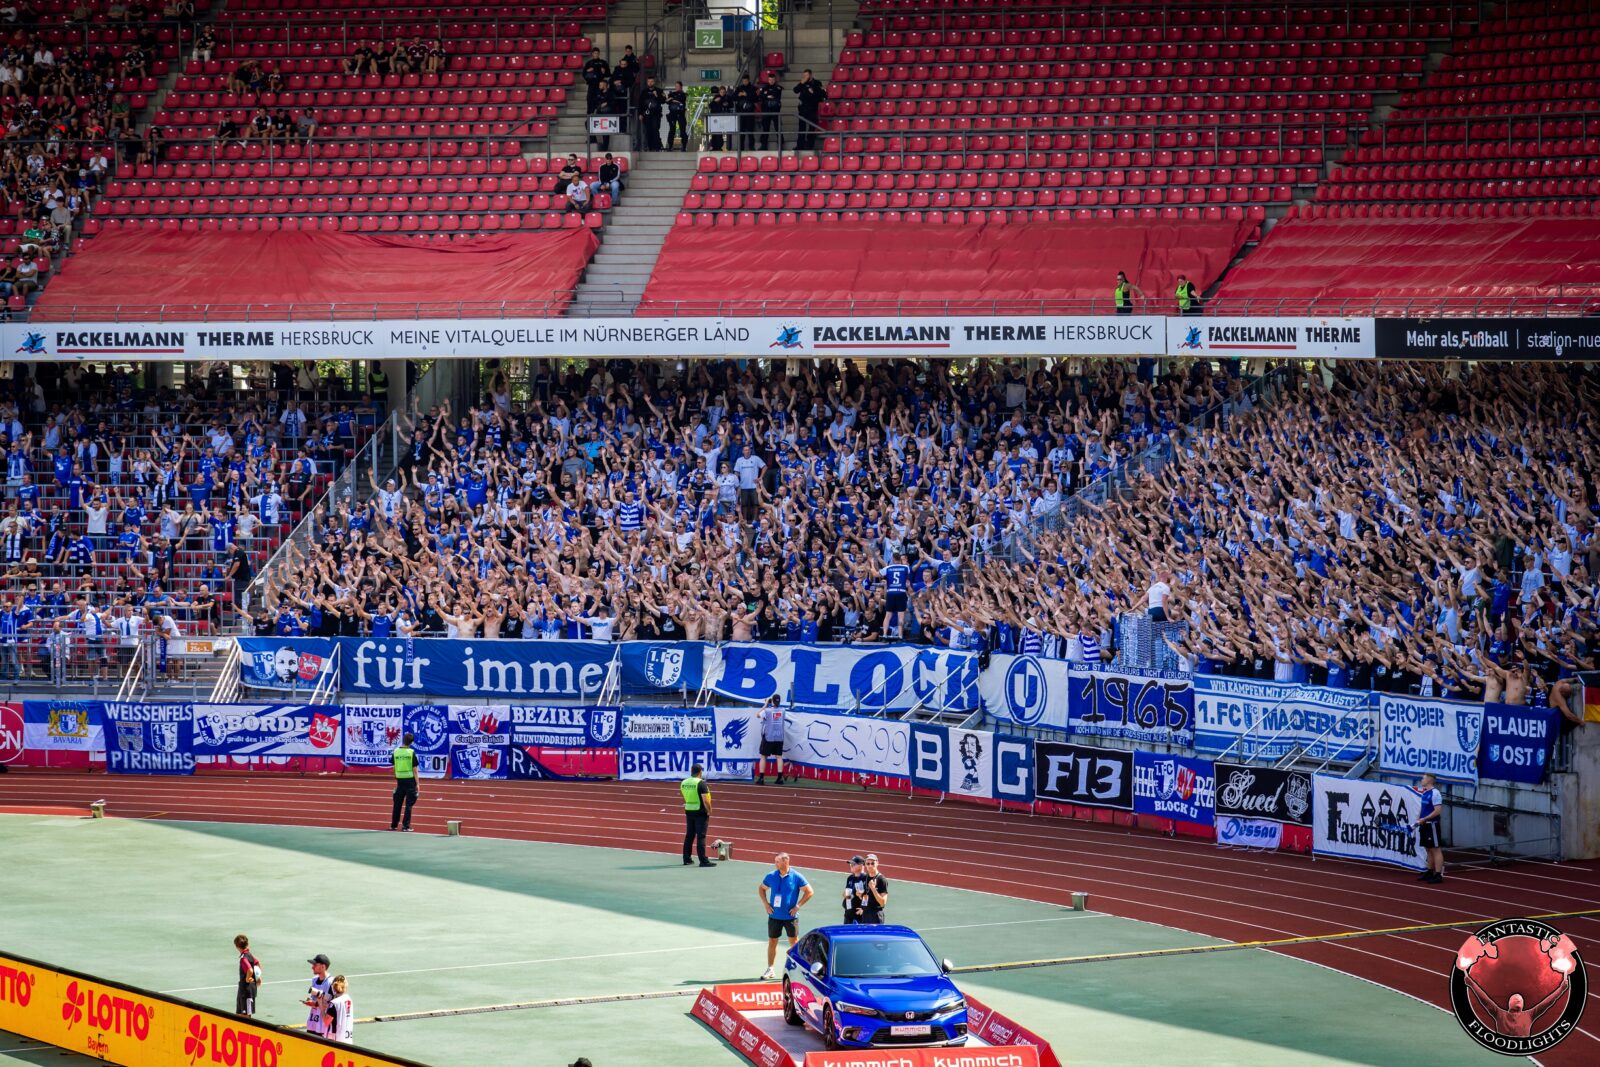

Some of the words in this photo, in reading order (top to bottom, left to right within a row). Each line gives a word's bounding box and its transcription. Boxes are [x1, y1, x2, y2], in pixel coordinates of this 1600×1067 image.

[703, 35, 715, 45] 24
[593, 118, 617, 130] FCN
[57, 331, 184, 347] FACKELMANN
[197, 331, 274, 346] THERME
[281, 330, 374, 346] HERSBRUCK
[390, 330, 440, 344] MEINE
[443, 328, 554, 346] VITALQUELLE
[559, 329, 578, 343] IM
[583, 325, 699, 342] NÜRNBERGER
[704, 326, 750, 341] LAND
[813, 326, 950, 341] FACKELMANN
[964, 325, 1046, 340] THERME
[1054, 325, 1153, 340] HERSBRUCK
[1208, 326, 1297, 343] FACKELMANN
[1305, 326, 1361, 343] THERME
[1406, 330, 1438, 348] Mehr
[1440, 330, 1459, 348] als
[1461, 330, 1509, 348] Fußball
[893, 571, 900, 585] 5
[353, 640, 430, 689] für
[650, 650, 681, 665] 1.FC
[647, 662, 680, 687] MAGDEBURG
[715, 646, 979, 714] BLOCK
[1143, 669, 1160, 678] NICHT
[1163, 671, 1194, 681] VERLOREN
[1210, 680, 1227, 692] WIR
[1228, 681, 1265, 696] KÄMPFEN
[1265, 687, 1281, 699] MIT
[104, 703, 193, 722] WEISSENFELS
[346, 706, 402, 718] FANCLUB
[1081, 674, 1189, 732] 1965
[226, 711, 309, 732] BÖRDE
[512, 706, 587, 726] BEZIRK
[1198, 700, 1242, 727] 1.FC
[1459, 715, 1479, 730] 1.FC
[1384, 724, 1412, 746] 1.FC
[1487, 715, 1547, 738] PLAUEN
[53, 736, 82, 745] BAVARIA
[513, 733, 586, 746] NEUNUNDDREISSIG
[111, 750, 195, 770] PIRANHAS
[623, 751, 723, 774] BREMEN
[914, 731, 943, 780] B
[997, 740, 1029, 796] G
[1384, 744, 1478, 774] MAGDEBURG
[1502, 746, 1533, 766] OST
[1217, 769, 1285, 813] Sued
[1154, 800, 1189, 815] BLOCK
[1190, 806, 1199, 819] U
[1221, 818, 1278, 840] Dessau
[87, 989, 150, 1041] LOTTO
[87, 1036, 109, 1054] Bayern
[211, 1023, 278, 1067] LOTTO
